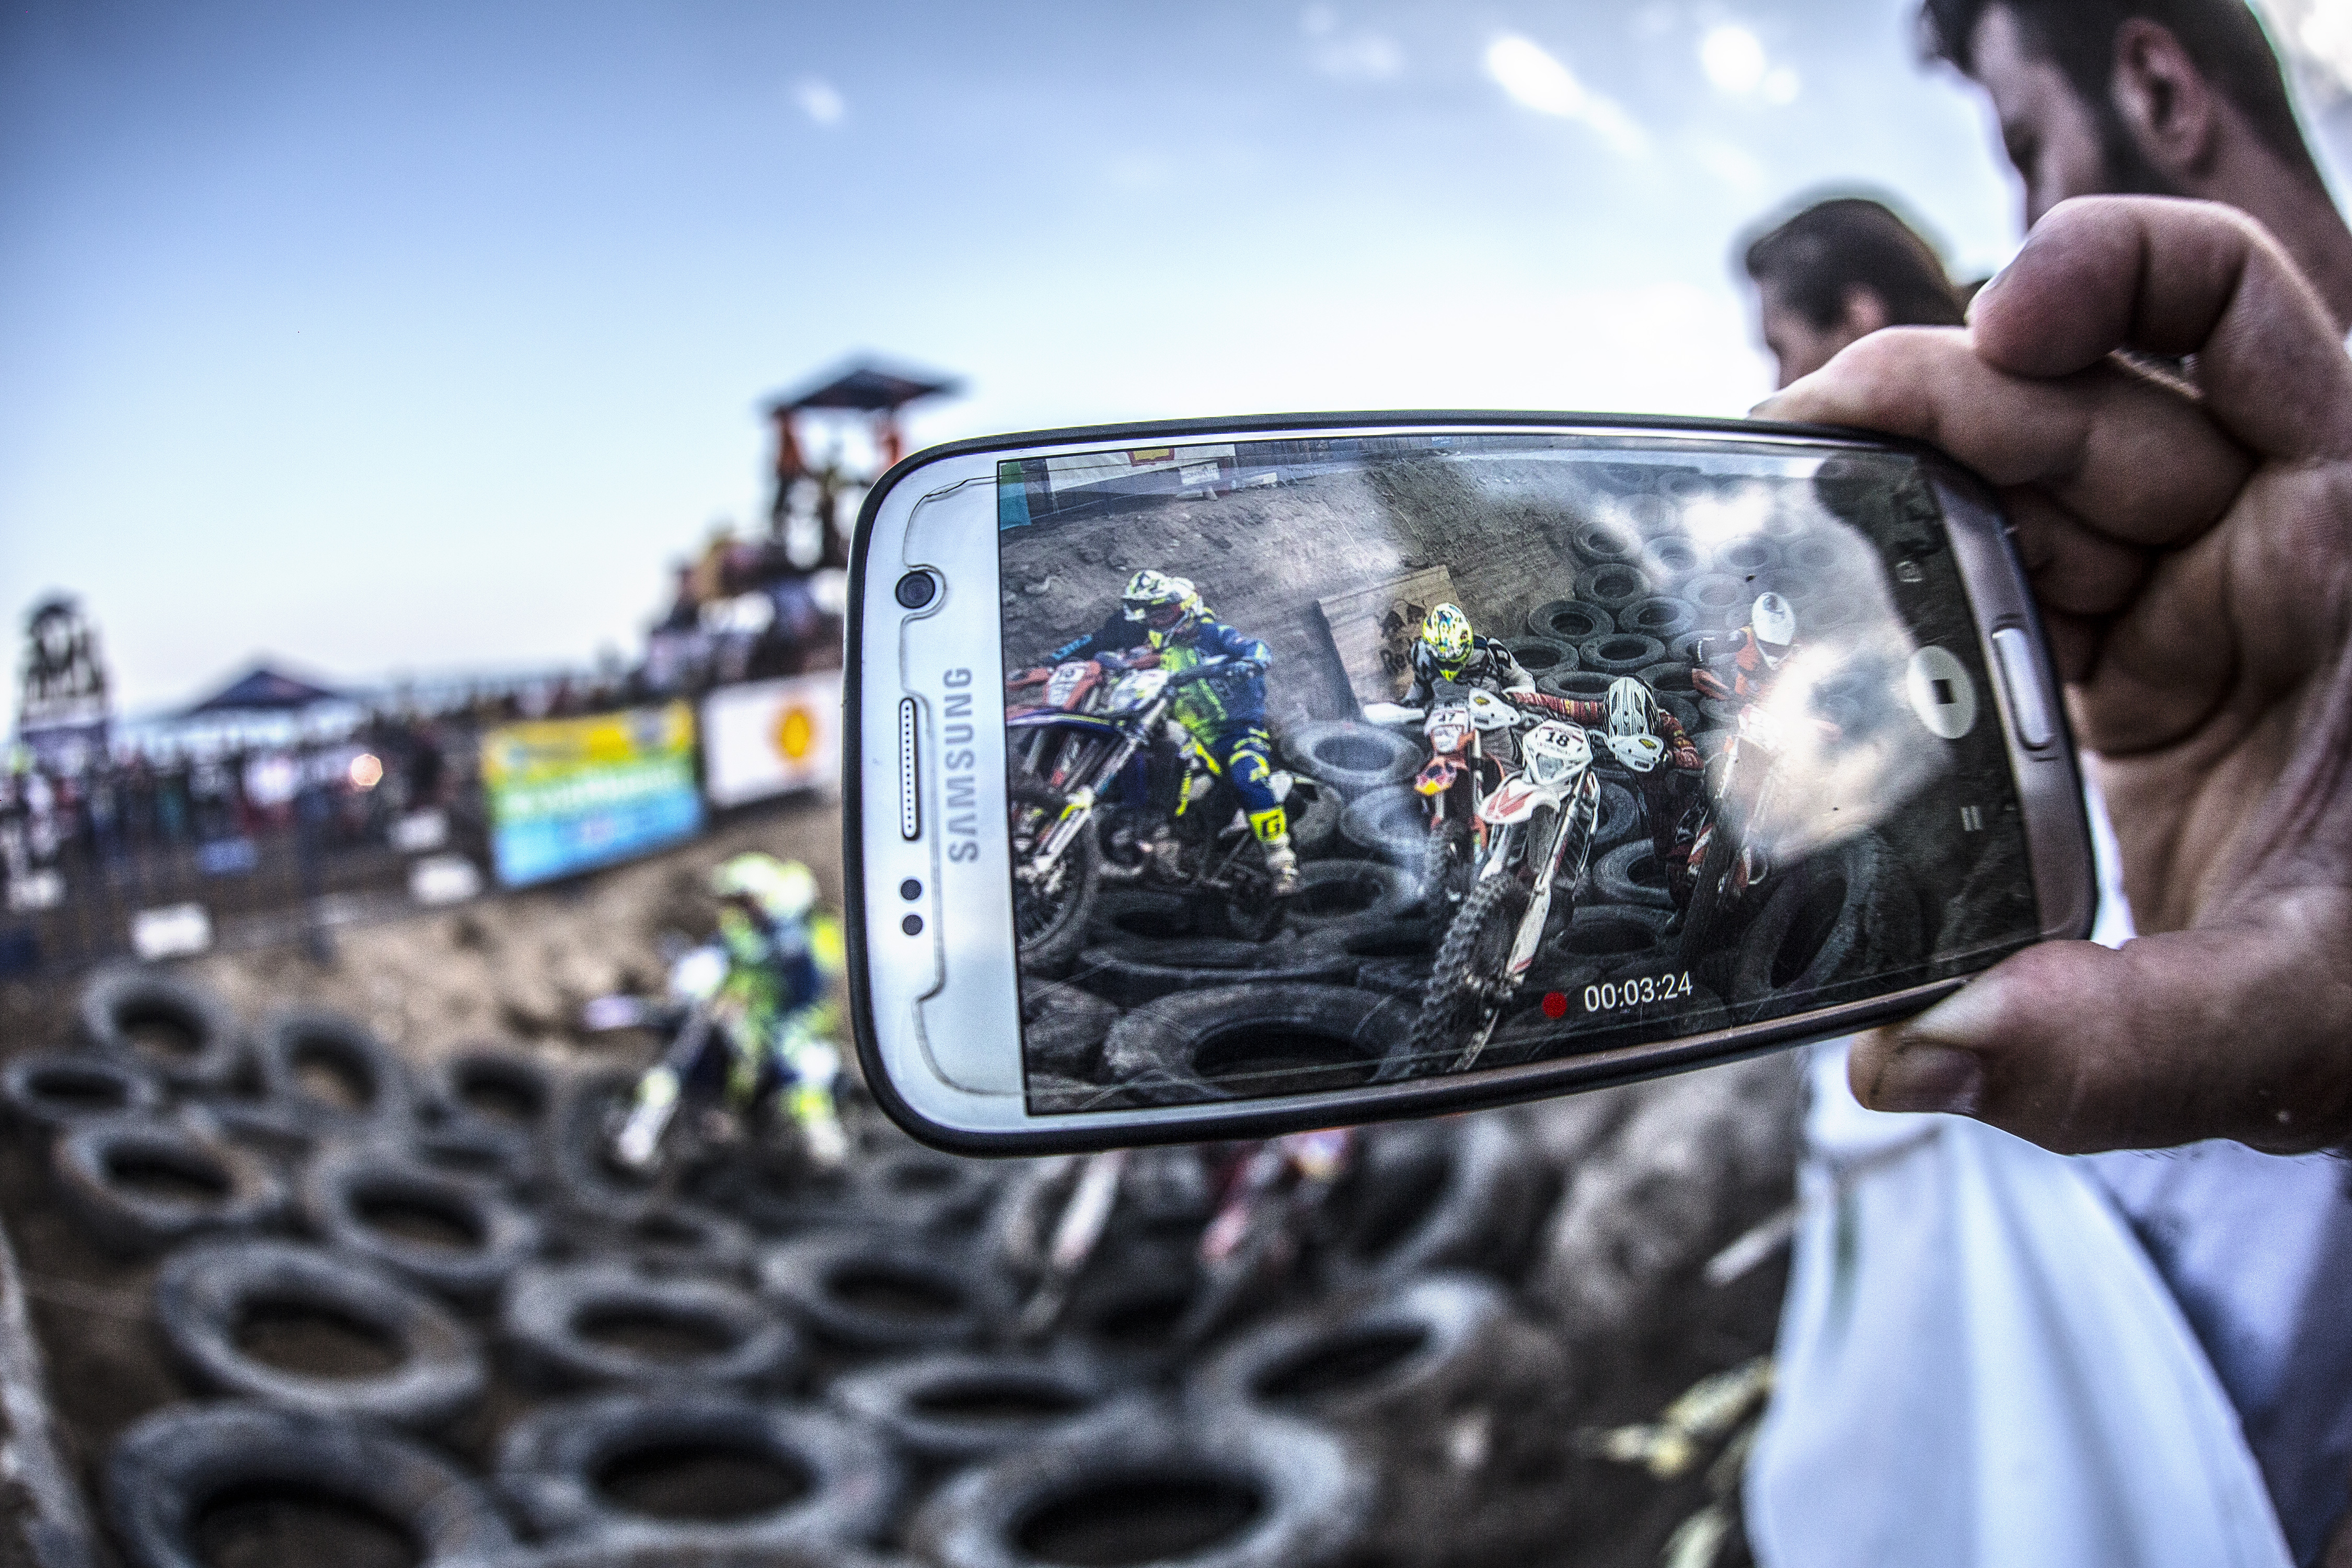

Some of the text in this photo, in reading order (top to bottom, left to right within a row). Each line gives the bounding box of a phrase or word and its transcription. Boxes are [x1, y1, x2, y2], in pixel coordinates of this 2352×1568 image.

[1546, 731, 1570, 747] 18
[943, 667, 979, 863] SAMSUNG
[1584, 971, 1693, 1012] 00:03:24
